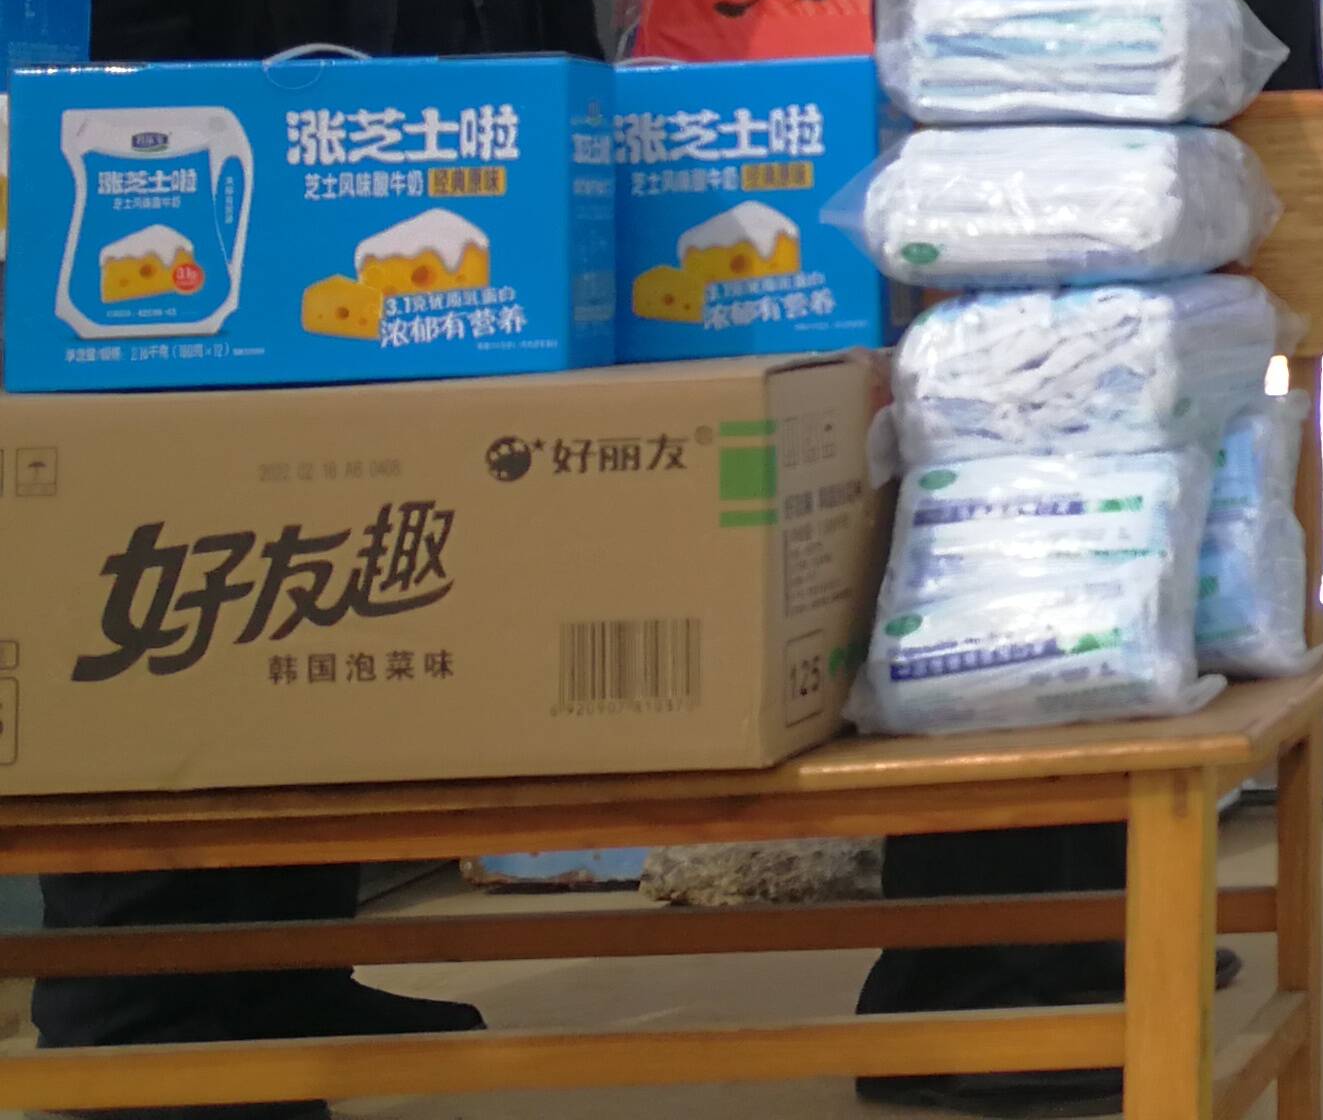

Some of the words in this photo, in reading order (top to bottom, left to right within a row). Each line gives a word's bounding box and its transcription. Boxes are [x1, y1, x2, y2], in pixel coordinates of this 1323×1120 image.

[286, 103, 520, 166] 涨芝士啦
[614, 102, 825, 165] 涨芝士啦
[97, 168, 198, 196] 涨芝士啦
[303, 170, 424, 201] 芝士风味酸牛奶
[379, 304, 528, 349] 浓郁有营养
[551, 434, 689, 475] 好丽友
[70, 499, 457, 682] 好友趣
[267, 649, 456, 685] 韩国泡菜味
